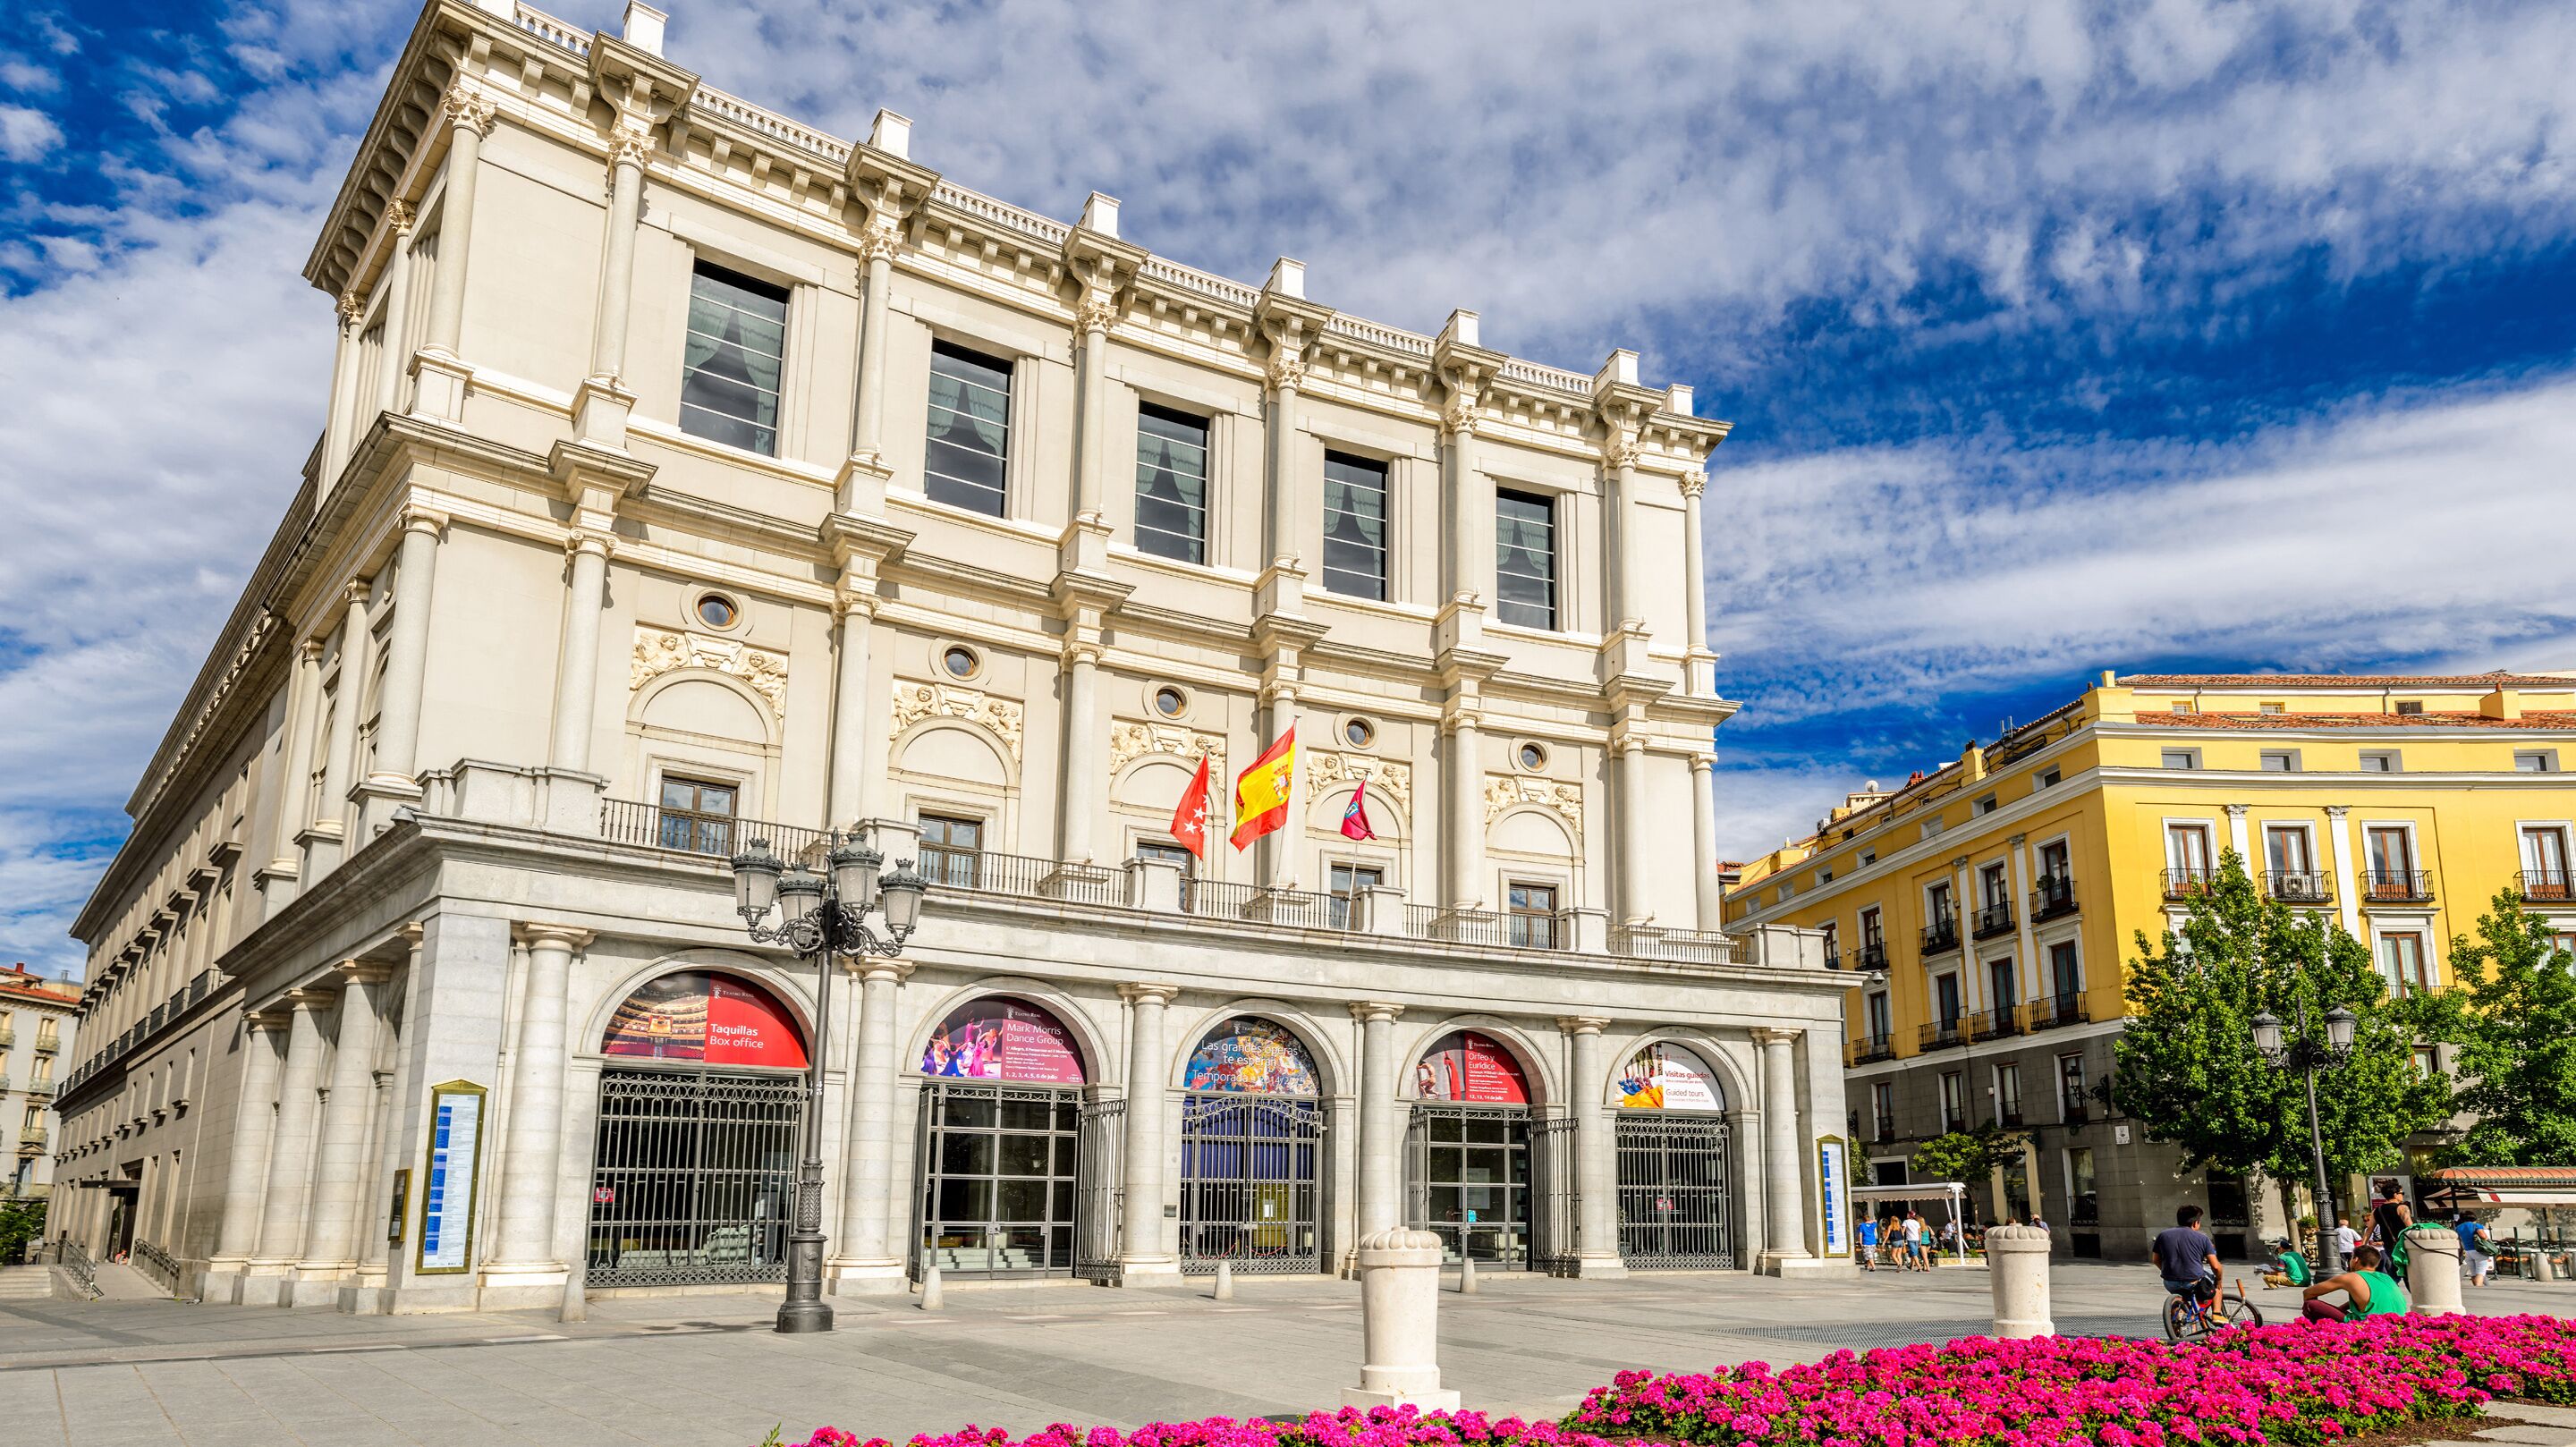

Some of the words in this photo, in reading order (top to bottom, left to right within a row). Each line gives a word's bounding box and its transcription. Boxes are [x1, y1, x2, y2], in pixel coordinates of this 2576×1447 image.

[710, 1023, 758, 1037] Taquillas
[1007, 1023, 1030, 1033] Mark
[1032, 1025, 1062, 1035] Morris
[709, 1036, 731, 1045] Box
[733, 1037, 764, 1049] office
[1006, 1033, 1035, 1044] Dance
[1037, 1035, 1063, 1045] Group
[1201, 1039, 1219, 1051] Las
[1221, 1042, 1262, 1054] grandes
[1223, 1054, 1234, 1064] te
[1236, 1056, 1276, 1067] esperan
[1468, 1052, 1489, 1061] Orfeo
[1469, 1062, 1496, 1070] Eurídice
[1192, 1069, 1249, 1086] Temporada
[1665, 1070, 1685, 1078] Visitas
[1686, 1071, 1710, 1080] guiadas
[1665, 1088, 1688, 1096] Guided
